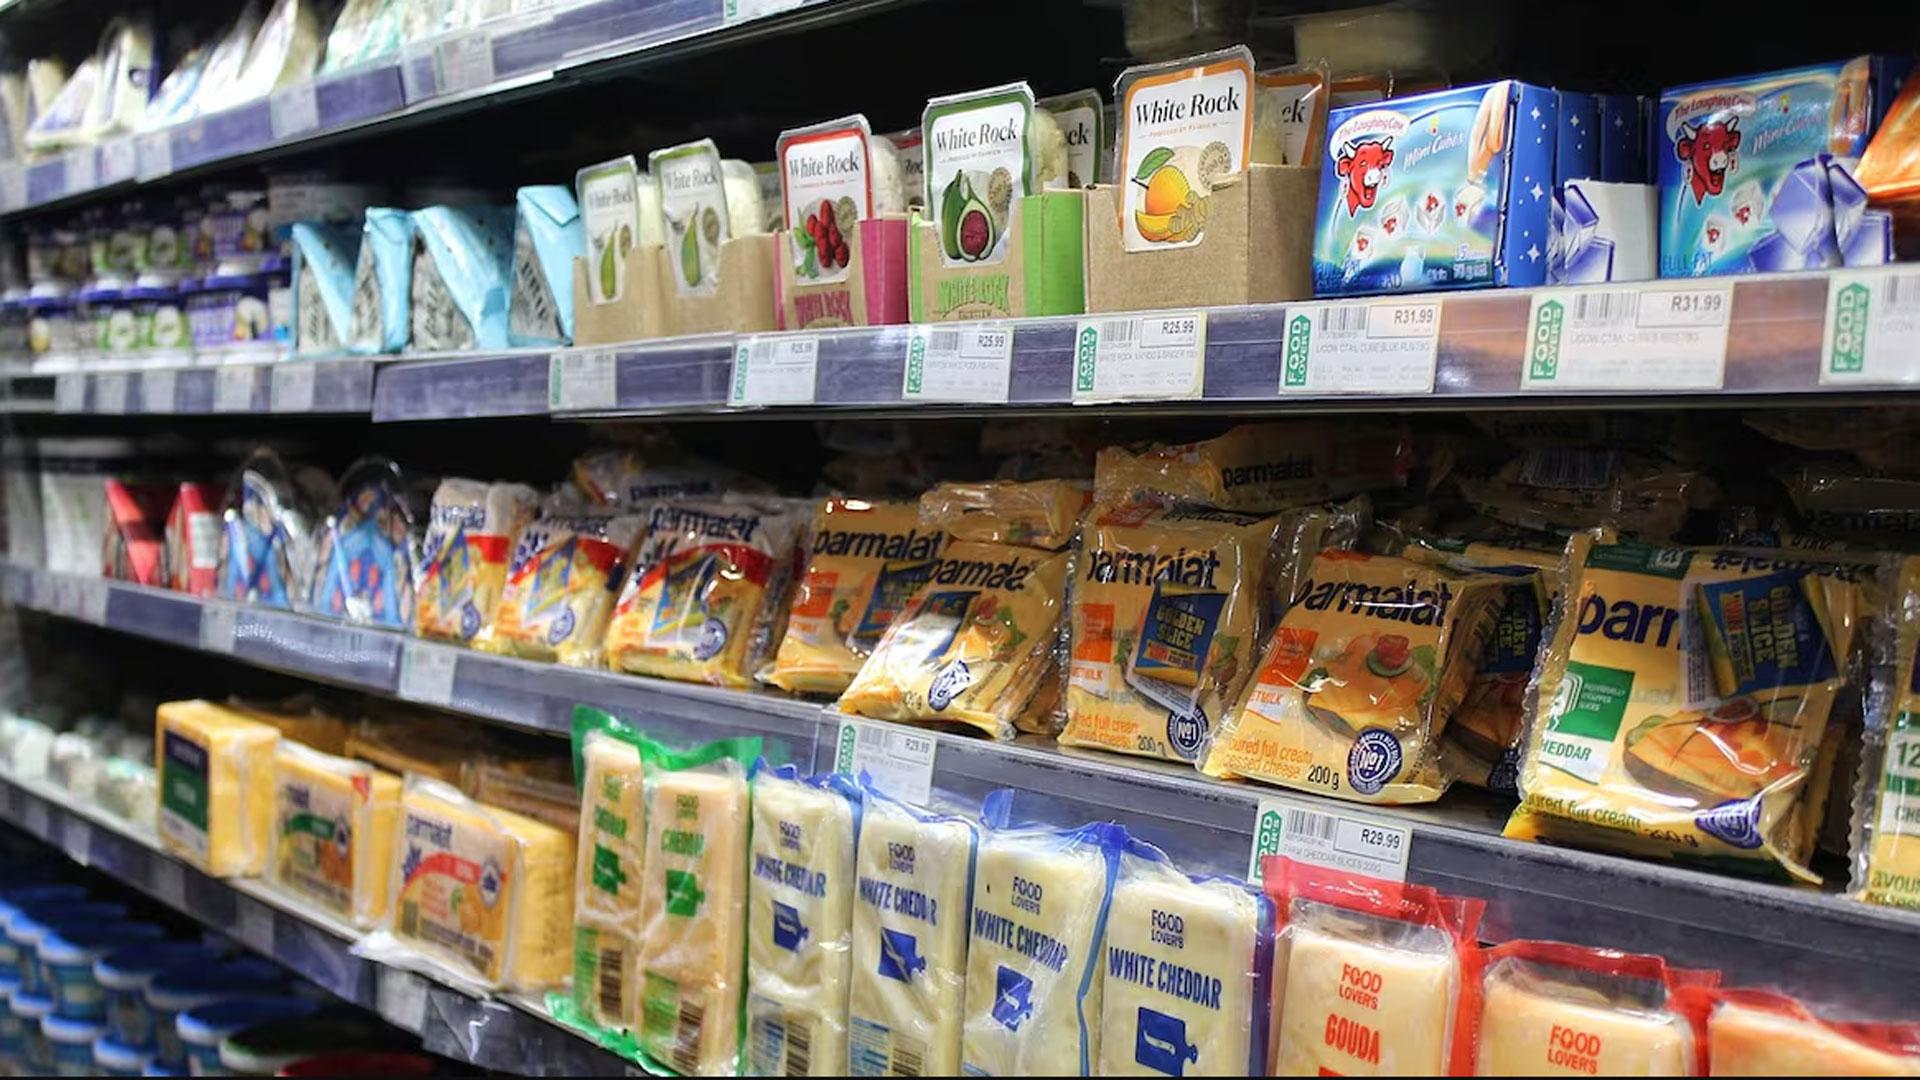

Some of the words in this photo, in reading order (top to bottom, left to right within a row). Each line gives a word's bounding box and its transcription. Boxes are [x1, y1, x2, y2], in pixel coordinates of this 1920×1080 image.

[1136, 99, 1185, 126] White
[1190, 87, 1239, 117] Rock
[1689, 94, 1733, 115] Laughing
[937, 127, 977, 151] White
[980, 118, 1017, 144] Rock
[1403, 142, 1431, 171] Mini
[1431, 129, 1465, 154] Cubes
[789, 157, 824, 178] White
[826, 151, 860, 174] Rock
[1394, 308, 1434, 325] R31.99
[1671, 294, 1722, 312] R31.99
[978, 334, 1006, 348] R25.99
[1161, 320, 1195, 335] R25.99
[1534, 306, 1551, 376] FOOD
[1834, 290, 1856, 369] FOOD
[1079, 332, 1089, 389] FOOD
[1287, 321, 1302, 384] FOOD
[1222, 453, 1314, 491] parmalat
[650, 506, 759, 542] parmalat
[813, 529, 943, 561] parmalat
[1262, 739, 1278, 758] full
[1279, 746, 1313, 764] cream
[1541, 739, 1593, 762] HEDDAR
[1262, 758, 1301, 779] cheese
[1307, 764, 1330, 785] 200
[1331, 772, 1341, 790] g
[1593, 804, 1641, 829] cream
[888, 842, 916, 862] FOOD
[1361, 828, 1400, 849] R29.99
[859, 876, 893, 911] WHITE
[1012, 876, 1043, 901] FOOD
[1151, 909, 1184, 934] FOOD
[974, 907, 1015, 948] WHITE
[1016, 924, 1069, 974] CHEDDAR
[1151, 929, 1184, 949] LOVER'S
[1109, 946, 1155, 986] WHITE
[1157, 961, 1222, 1011] CHEDDAR
[1341, 963, 1383, 993] FOOD
[1338, 985, 1379, 1010] LOVER'S
[1324, 1012, 1380, 1065] GOUDA
[1549, 1024, 1601, 1058] FOOD
[1547, 1047, 1599, 1076] LOVER'S
